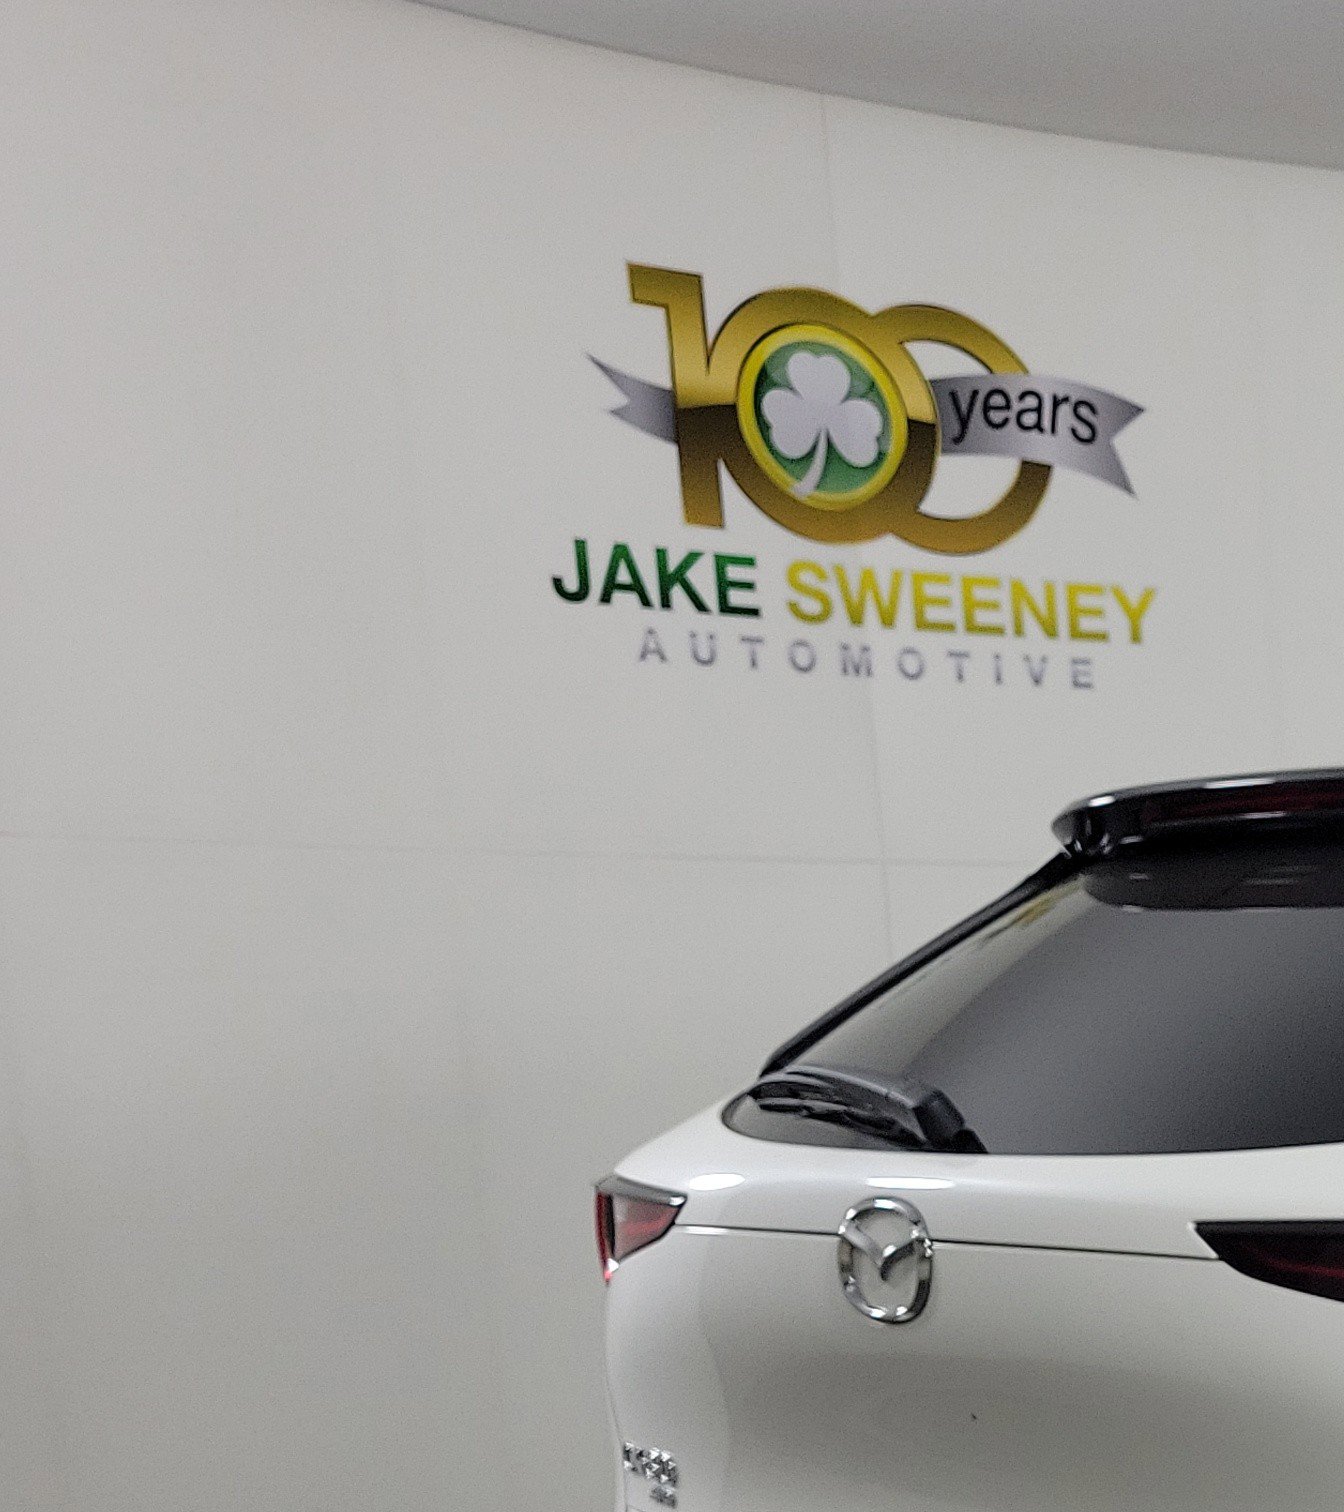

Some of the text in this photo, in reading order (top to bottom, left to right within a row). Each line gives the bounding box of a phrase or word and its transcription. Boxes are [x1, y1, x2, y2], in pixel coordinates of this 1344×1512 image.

[626, 260, 1053, 556] 100
[949, 388, 1098, 445] years
[550, 537, 1157, 646] JAKE SWEENEY
[639, 628, 1096, 691] AUTOMOTIVE
